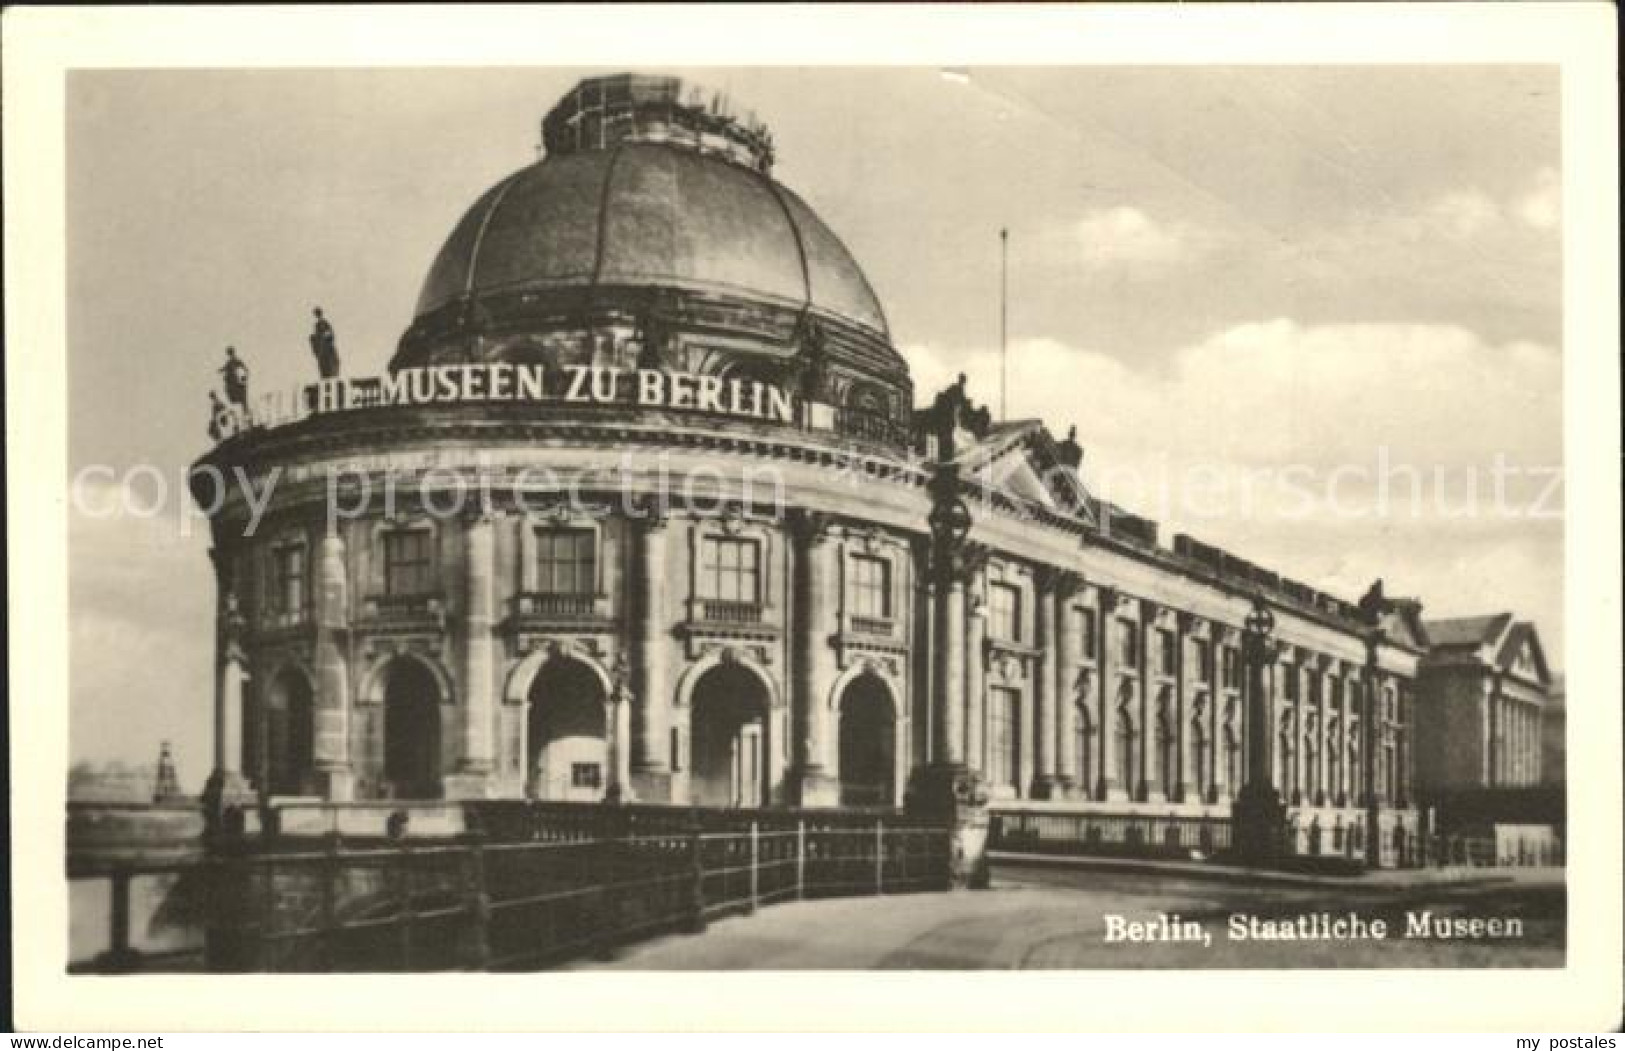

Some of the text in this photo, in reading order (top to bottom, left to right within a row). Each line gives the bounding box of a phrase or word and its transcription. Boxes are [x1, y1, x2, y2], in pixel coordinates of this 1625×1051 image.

[381, 363, 794, 422] MUSEEN ZU BERLIN
